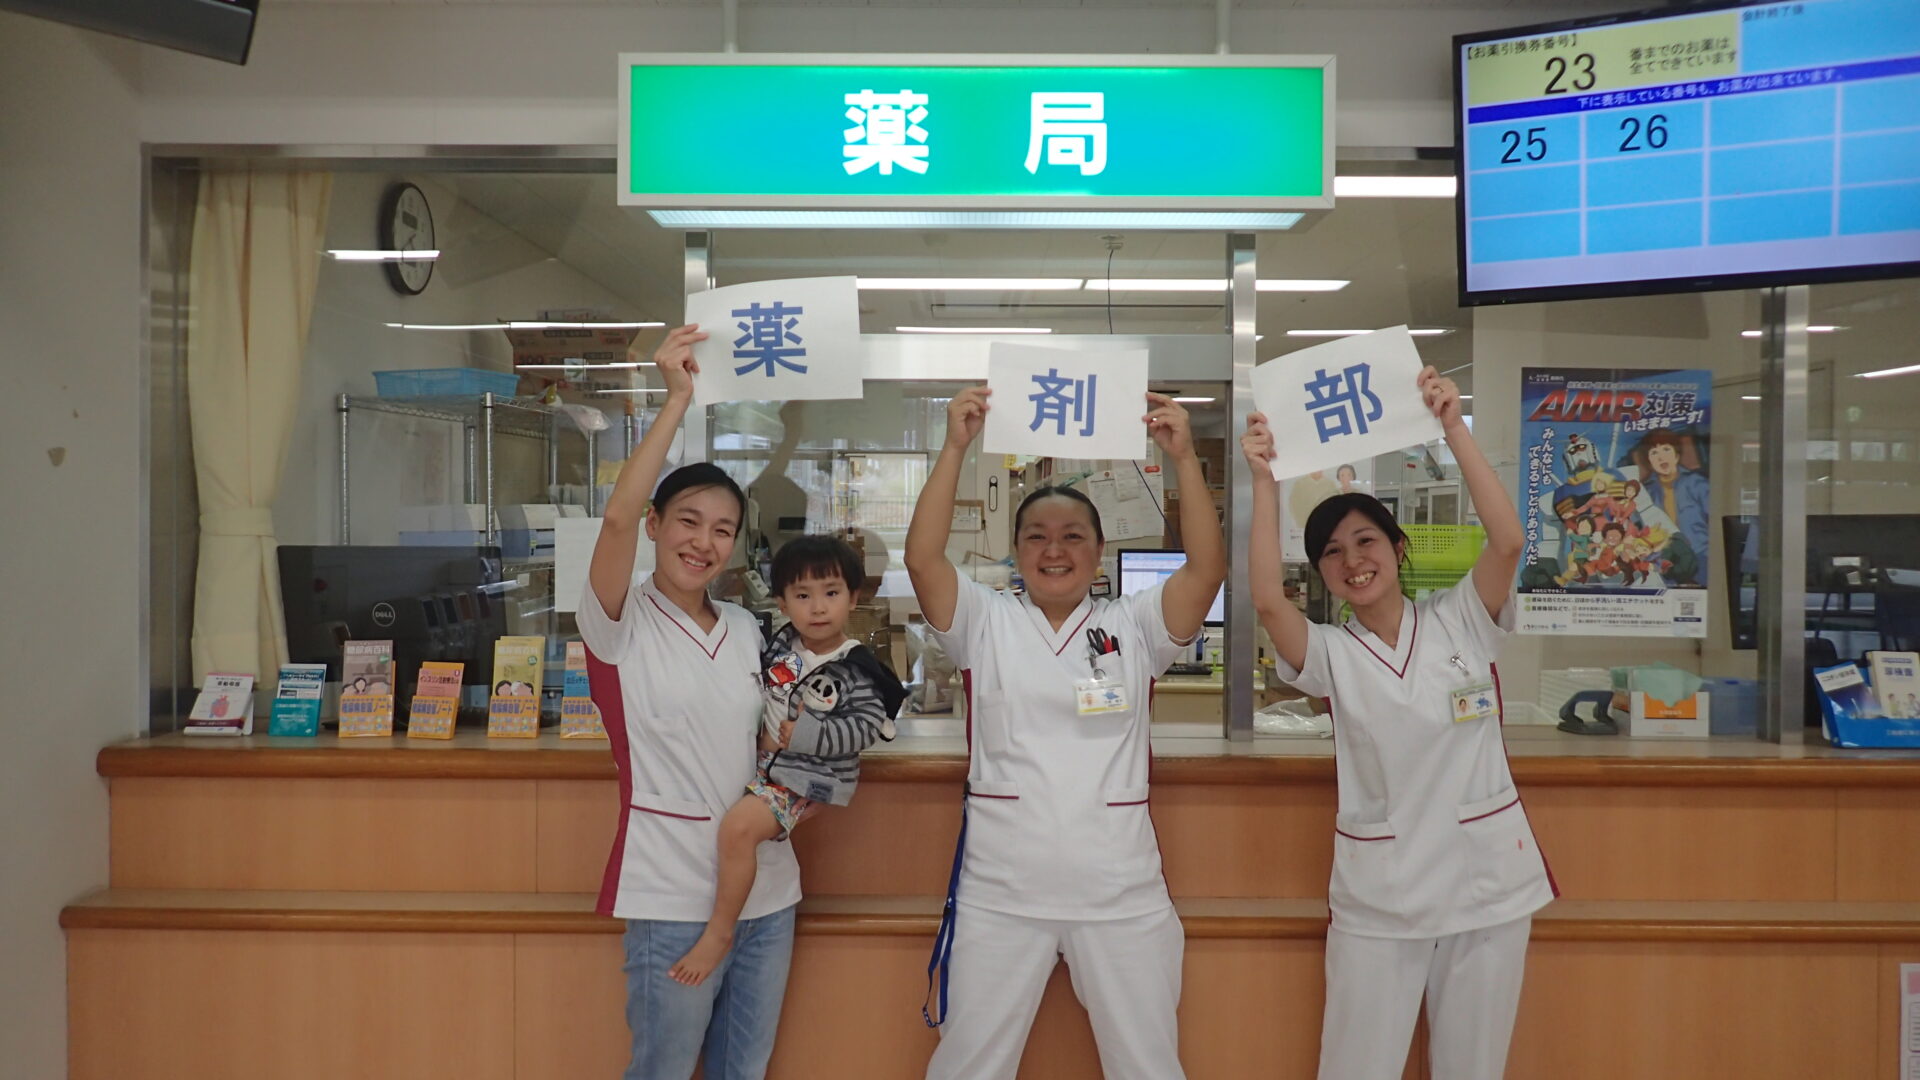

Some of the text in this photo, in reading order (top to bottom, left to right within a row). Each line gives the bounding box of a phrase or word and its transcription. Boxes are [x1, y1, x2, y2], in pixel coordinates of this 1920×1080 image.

[1467, 33, 1578, 60] 【お薬引換券番号】
[1630, 37, 1730, 61] 番までのお薬は
[1630, 50, 1737, 75] 全てできています
[1544, 53, 1597, 95] 23
[1577, 68, 1843, 109] 下に表示している番号も、お薬が出来ています。
[1500, 127, 1548, 164] 25
[1618, 114, 1669, 153] 26
[731, 301, 808, 378] 薬
[1028, 367, 1098, 438] 剤
[1304, 361, 1384, 444] 部
[1542, 427, 1555, 486] みんなにも
[1526, 445, 1542, 566] できることがあるんだ
